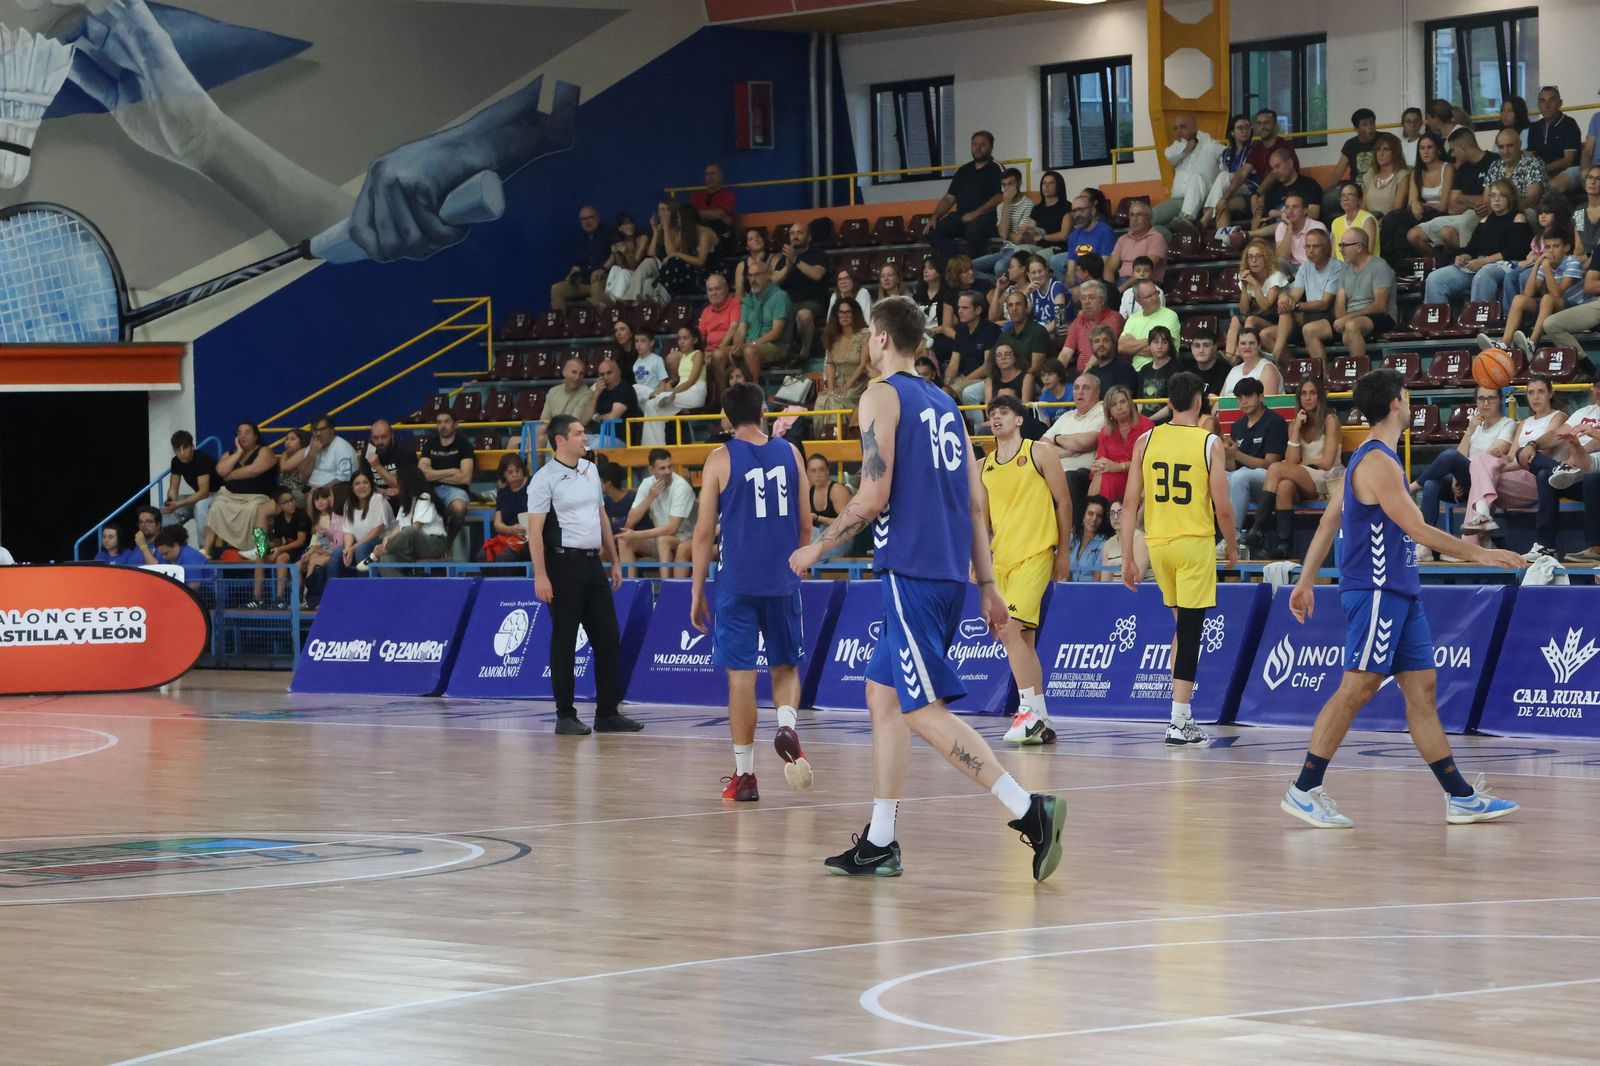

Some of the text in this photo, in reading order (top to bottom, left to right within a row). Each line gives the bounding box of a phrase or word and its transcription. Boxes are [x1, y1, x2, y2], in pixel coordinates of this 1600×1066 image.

[1300, 362, 1312, 373] 36
[920, 408, 962, 471] 16
[1152, 462, 1192, 504] 35
[744, 466, 788, 518] 11
[0, 610, 142, 624] ALONCESTO
[0, 624, 142, 642] STILLA Y LEÓN
[654, 654, 714, 664] VALDERADUE
[948, 640, 1008, 670] elguiades
[1054, 644, 1116, 669] FITECU
[1297, 646, 1345, 666] INNO
[1432, 646, 1470, 668] OVA
[478, 666, 516, 678] ZAMORANO
[1066, 673, 1095, 681] INTERNACIONAL
[1047, 680, 1076, 689] INNOVACIÓN
[1080, 681, 1111, 690] TECNOLOGÍA
[1133, 681, 1163, 690] INNOVACIÓN
[1292, 672, 1325, 692] Chef
[1083, 690, 1107, 698] CUIDADOS
[1136, 690, 1156, 699] SERVICIO
[1513, 689, 1600, 705] CAJA RURAL
[1518, 706, 1582, 718] DE ZAMORA
